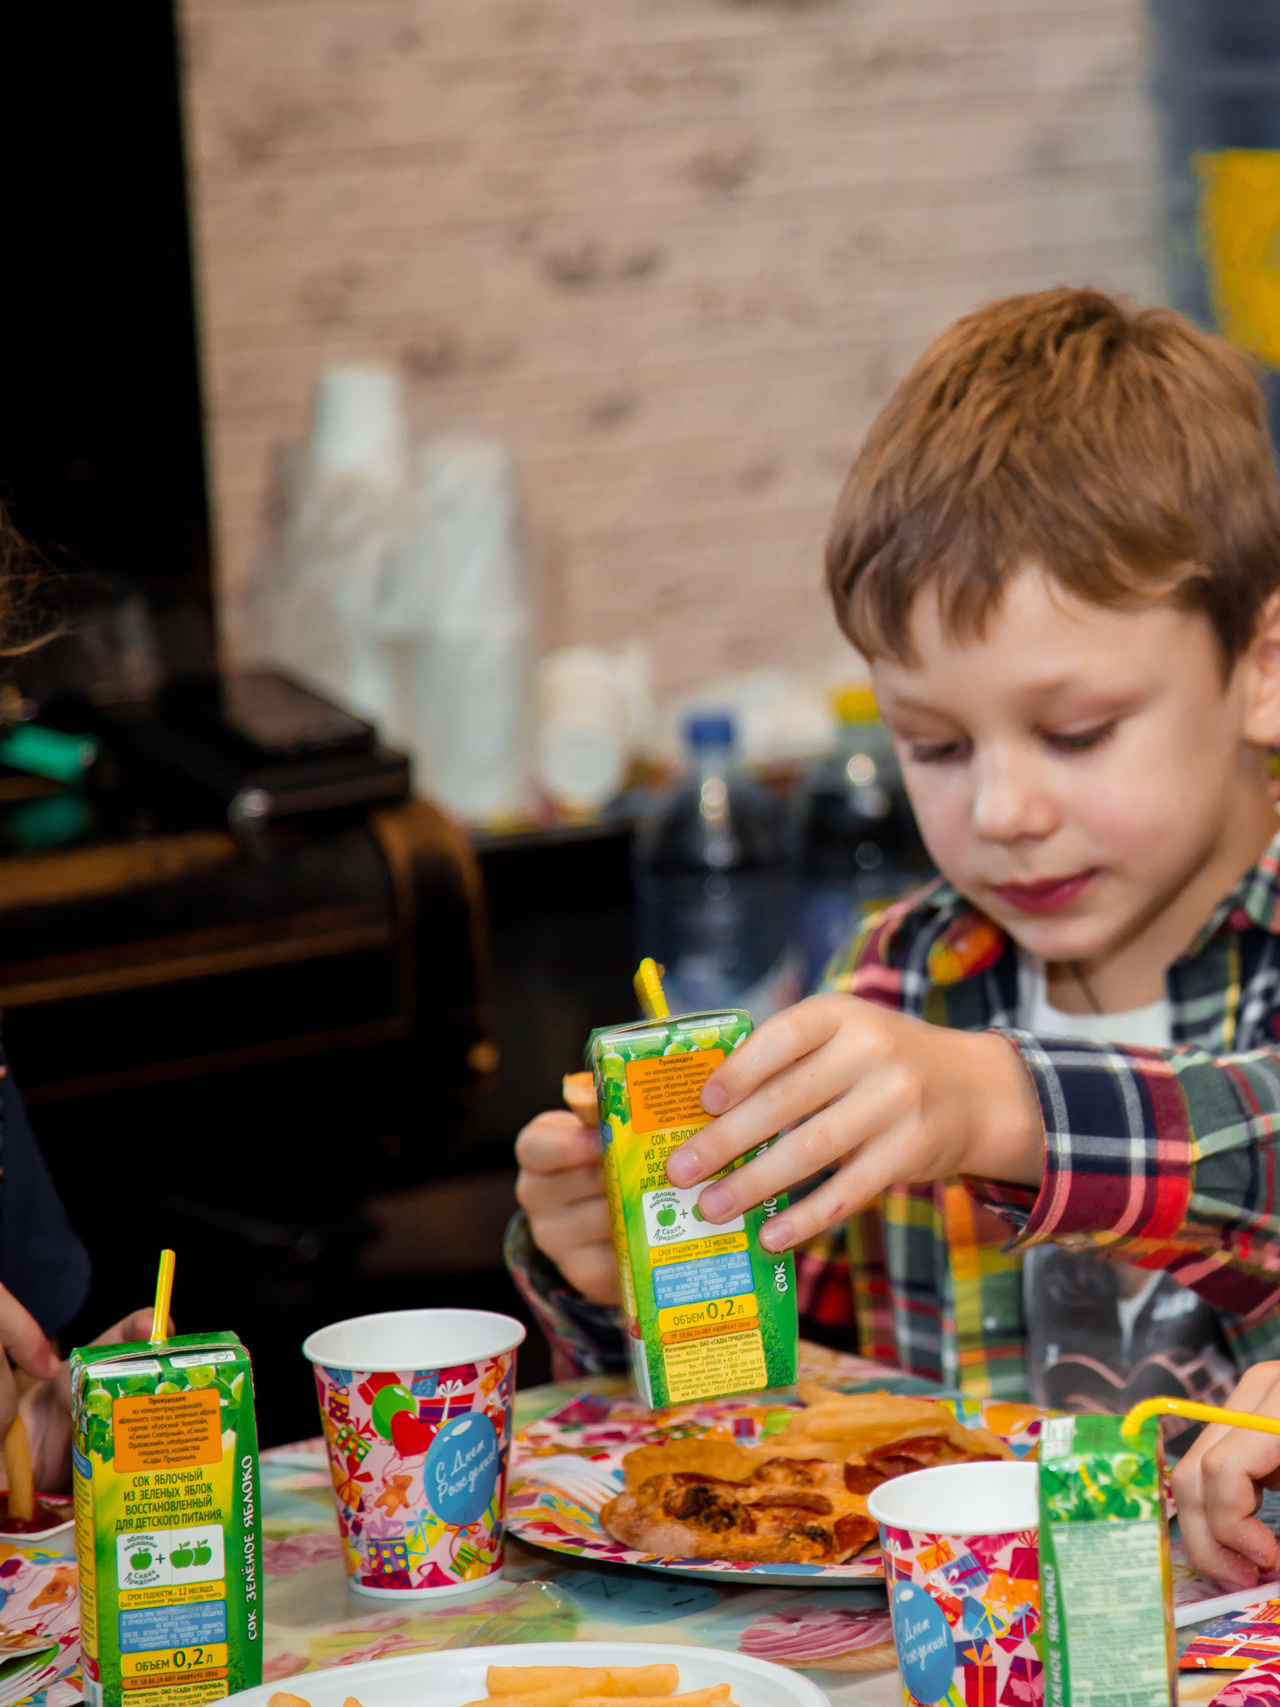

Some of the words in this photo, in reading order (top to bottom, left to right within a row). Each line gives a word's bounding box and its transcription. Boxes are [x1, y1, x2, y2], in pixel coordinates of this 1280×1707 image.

[651, 1134, 667, 1145] СОК
[644, 1149, 655, 1160] ИЗ
[641, 1177, 656, 1190] ДЛЯ
[652, 1191, 676, 1200] яблоки
[649, 1197, 680, 1209] выращены
[654, 1229, 686, 1241] Придонья
[662, 1225, 681, 1234] Садах
[673, 1243, 699, 1254] ГОДНОСТИ
[704, 1240, 711, 1248] 12
[774, 1261, 788, 1292] СОК
[673, 1312, 705, 1325] ОБЪЕМ
[707, 1299, 735, 1320] 0,2
[738, 1305, 744, 1314] л
[711, 1337, 727, 1346] «САДЫ
[133, 1476, 150, 1487] СОК
[154, 1468, 203, 1485] ЯБЛОЧНЫЙ
[436, 1461, 446, 1483] С
[124, 1491, 135, 1501] ИЗ
[140, 1487, 180, 1500] ЗЕЛЕНЫХ
[185, 1483, 213, 1496] ЯБЛОК
[241, 1454, 254, 1528] ЯБЛОКО
[125, 1495, 212, 1515] ВОССТАНОВЛЕННЫЙ
[115, 1519, 133, 1531] ДЛЯ
[135, 1514, 179, 1530] ДЕТСКОГО
[182, 1509, 224, 1524] ПИТАНИЯ.
[127, 1535, 154, 1543] яблоки
[123, 1541, 158, 1551] выращены
[240, 1532, 257, 1603] ЗЕЛЁНОЕ
[124, 1574, 160, 1585] Придонья
[134, 1570, 156, 1579] Садах
[144, 1590, 172, 1598] ГОДНОСТИ
[179, 1587, 187, 1595] 12
[1042, 1563, 1060, 1643] ЯБЛОКО
[247, 1608, 257, 1640] СОК
[136, 1659, 170, 1671] ОБЪЕМ
[173, 1648, 204, 1669] 0,2
[206, 1654, 213, 1663] л
